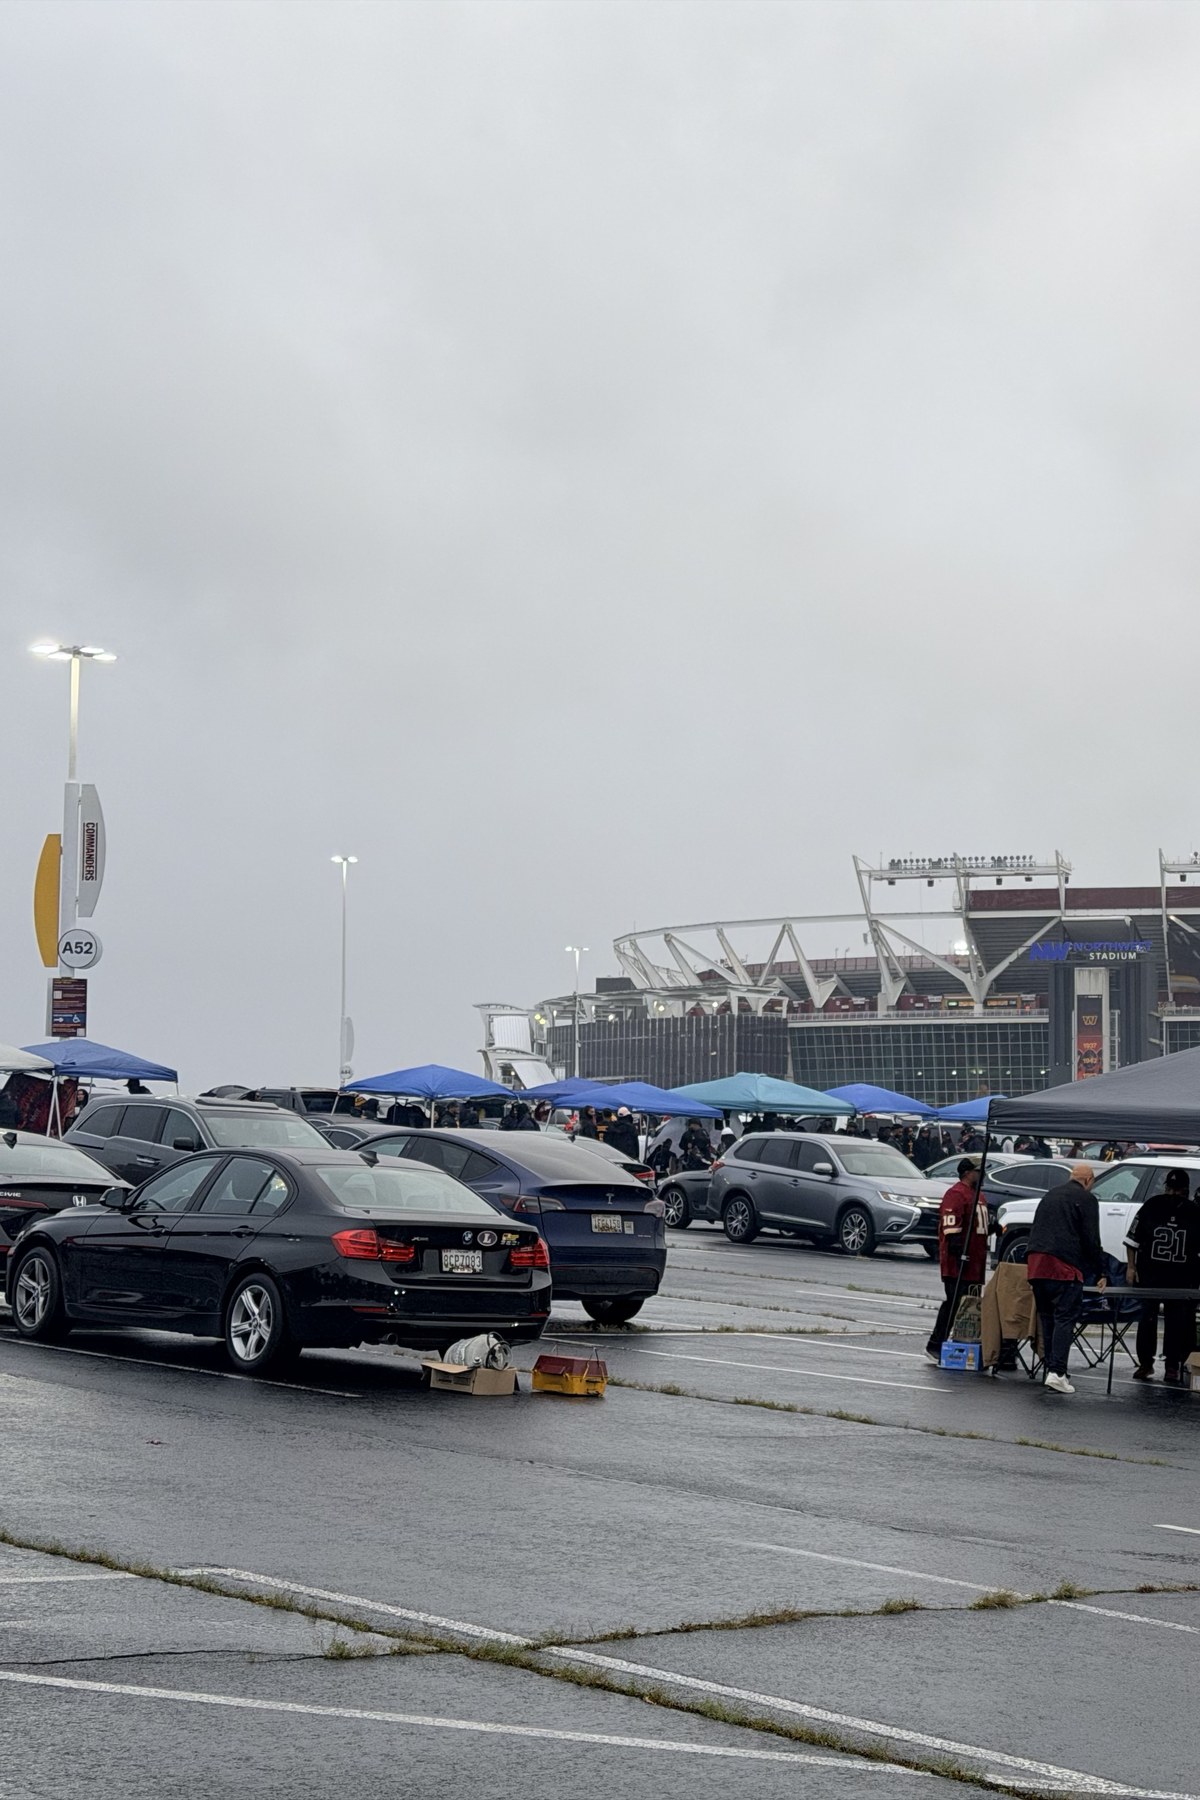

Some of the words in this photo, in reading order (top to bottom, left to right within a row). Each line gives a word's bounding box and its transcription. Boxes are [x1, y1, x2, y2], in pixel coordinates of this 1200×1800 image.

[85, 822, 96, 881] COMMANDERS
[62, 941, 93, 954] A52
[1073, 942, 1153, 952] NORTHWEST
[1089, 952, 1137, 960] STADIUM
[943, 1215, 956, 1226] 10
[1151, 1227, 1187, 1262] 21
